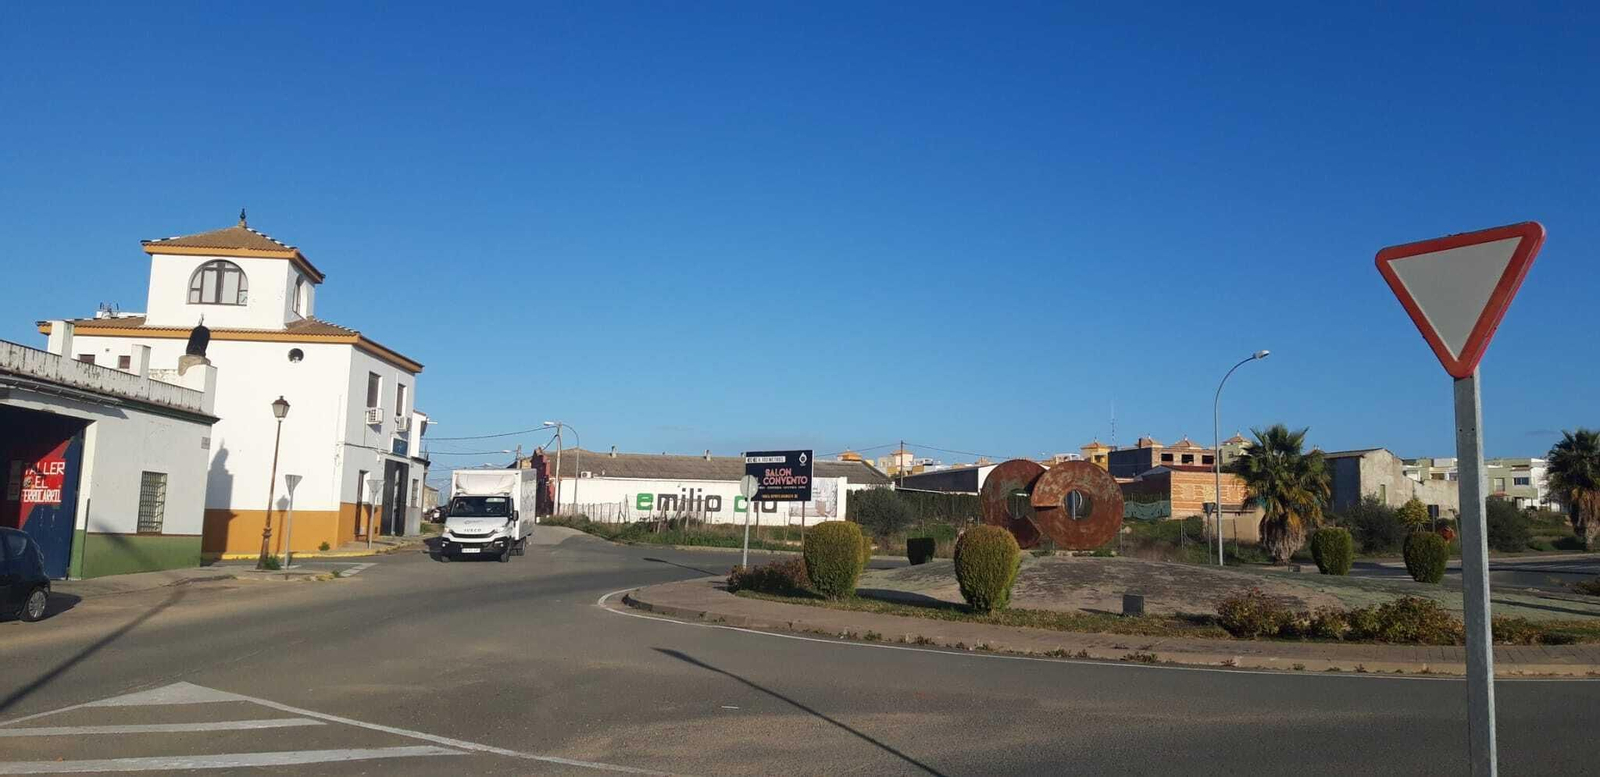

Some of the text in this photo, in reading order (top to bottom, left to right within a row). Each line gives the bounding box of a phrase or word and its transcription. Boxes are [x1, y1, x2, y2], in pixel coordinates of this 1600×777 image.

[34, 475, 48, 489] EL
[763, 476, 808, 486] CONVENTO
[636, 488, 722, 512] emilio
